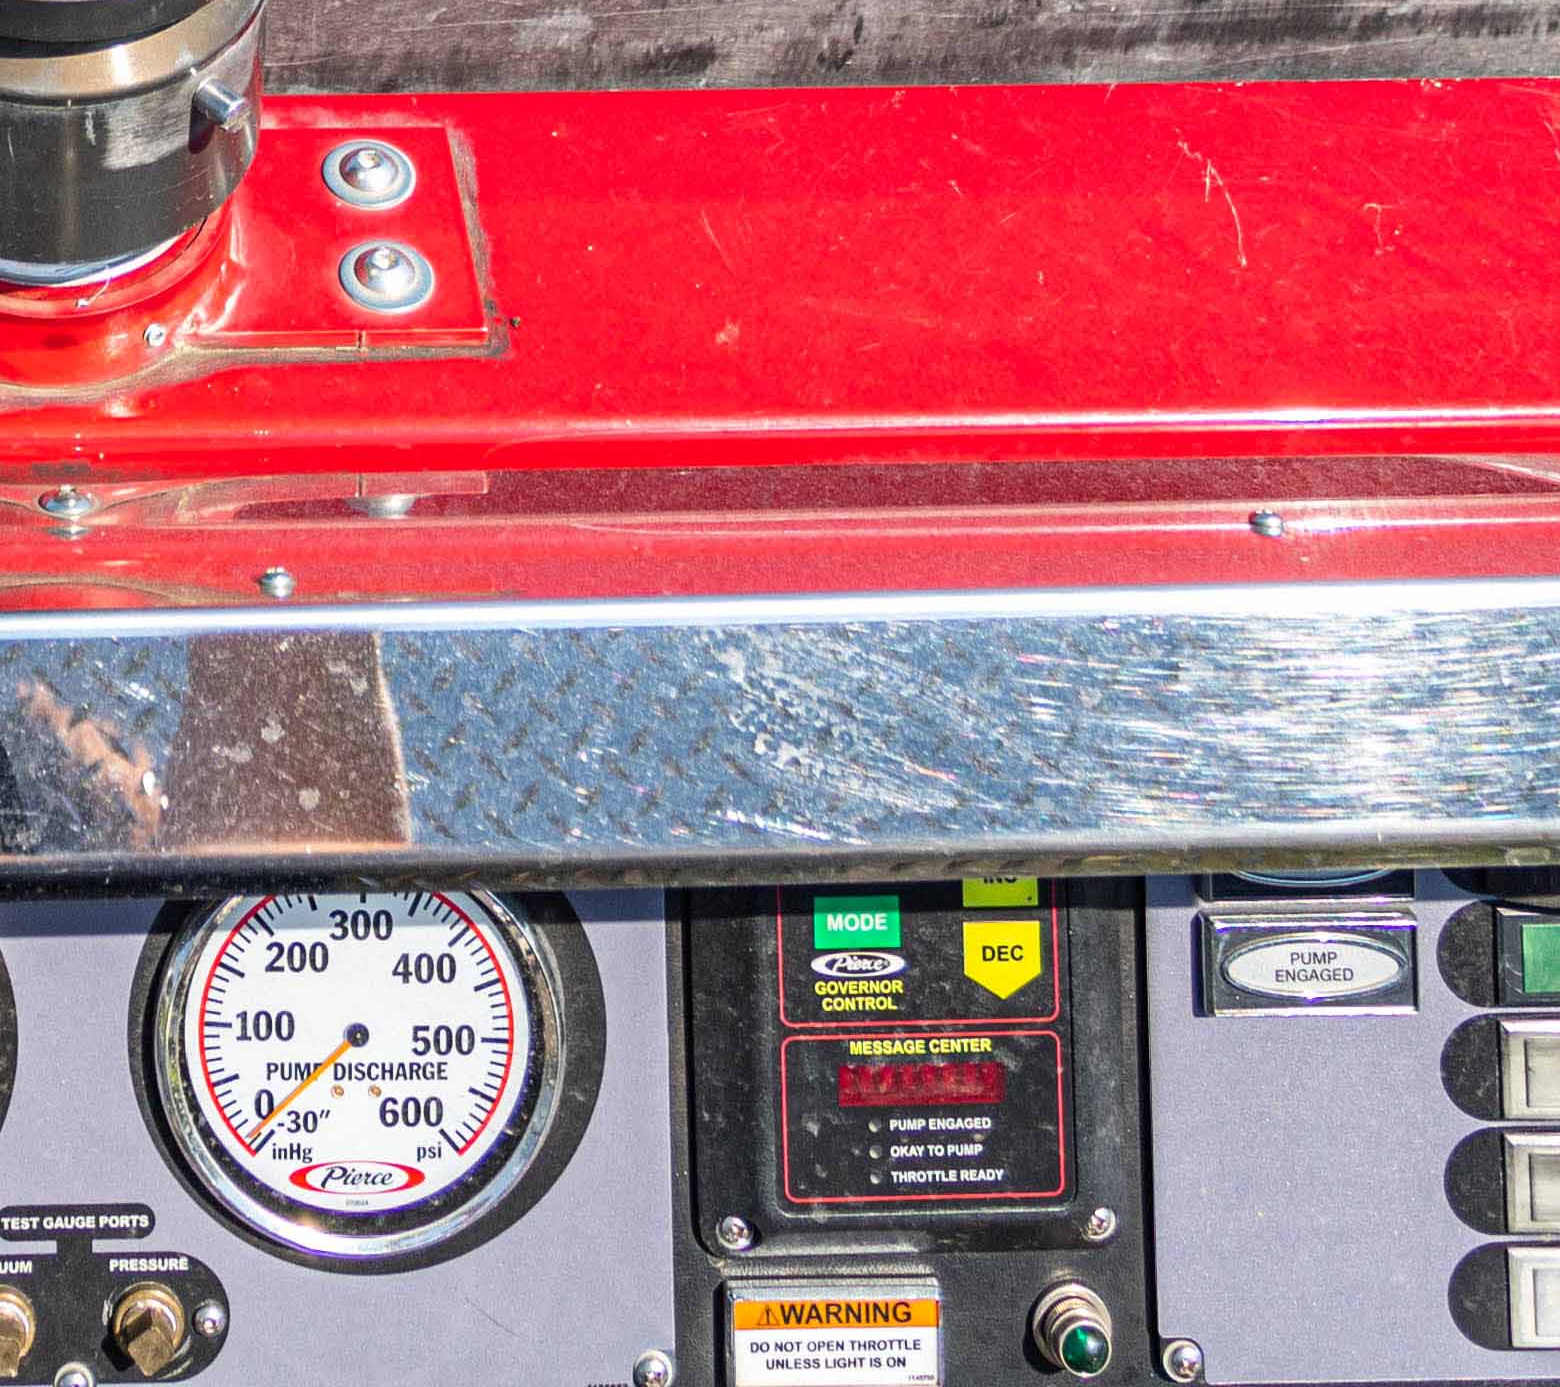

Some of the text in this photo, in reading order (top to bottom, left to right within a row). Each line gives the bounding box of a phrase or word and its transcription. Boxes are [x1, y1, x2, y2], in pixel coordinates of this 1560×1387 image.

[329, 909, 393, 941] 300
[827, 913, 888, 931] MODE
[265, 942, 329, 973] 200
[982, 945, 1024, 962] DEC
[1290, 951, 1338, 965] PUMP
[392, 953, 456, 984] 400
[832, 955, 884, 973] Pierce
[1274, 968, 1354, 983] ENGAGED
[815, 980, 903, 995] GOVERNOR
[822, 996, 898, 1011] CONTROL
[235, 1011, 295, 1042] 100
[411, 1025, 475, 1056] 500
[849, 1038, 992, 1055] MESSAGE CENTER
[334, 1062, 448, 1080] DISCHARGE
[254, 1089, 274, 1120] 0
[379, 1096, 443, 1127] 600
[889, 1117, 992, 1131] PUMP ENGAGED
[272, 1143, 313, 1163] inHg
[417, 1141, 442, 1162] psi
[890, 1144, 983, 1158] OKAY TO PUMP
[320, 1165, 393, 1189] Pierce
[891, 1169, 1004, 1183] THROTTLE READY
[1, 1215, 149, 1230] TEST GAUGE PORTS
[109, 1257, 189, 1272] PRESSURE
[780, 1302, 912, 1324] WARNING
[750, 1339, 921, 1353] DO NOT OPEN THROTTLE
[766, 1356, 907, 1370] UNLESS LIGHT IS ON
